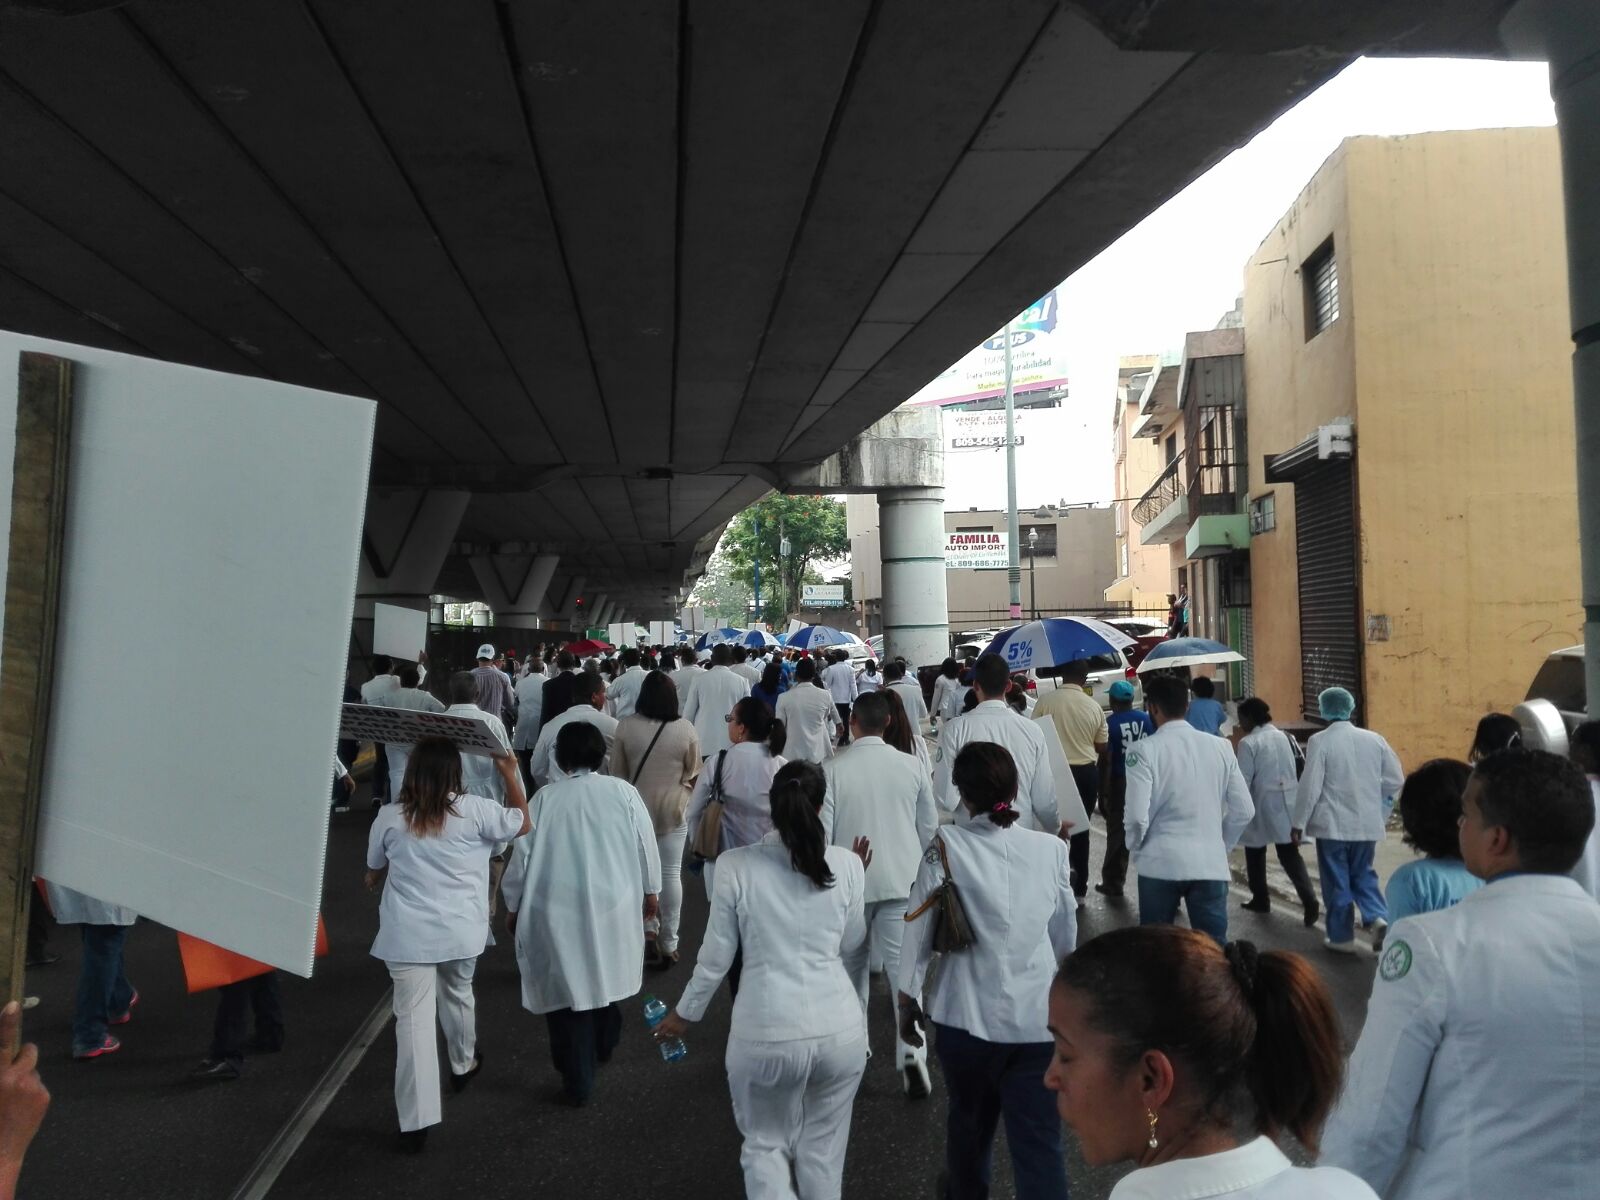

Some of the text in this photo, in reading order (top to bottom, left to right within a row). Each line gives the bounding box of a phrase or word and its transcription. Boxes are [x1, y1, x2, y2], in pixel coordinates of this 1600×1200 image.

[950, 534, 1000, 544] FAMILIA
[1007, 640, 1033, 660] 5%
[1120, 720, 1149, 748] 5%
